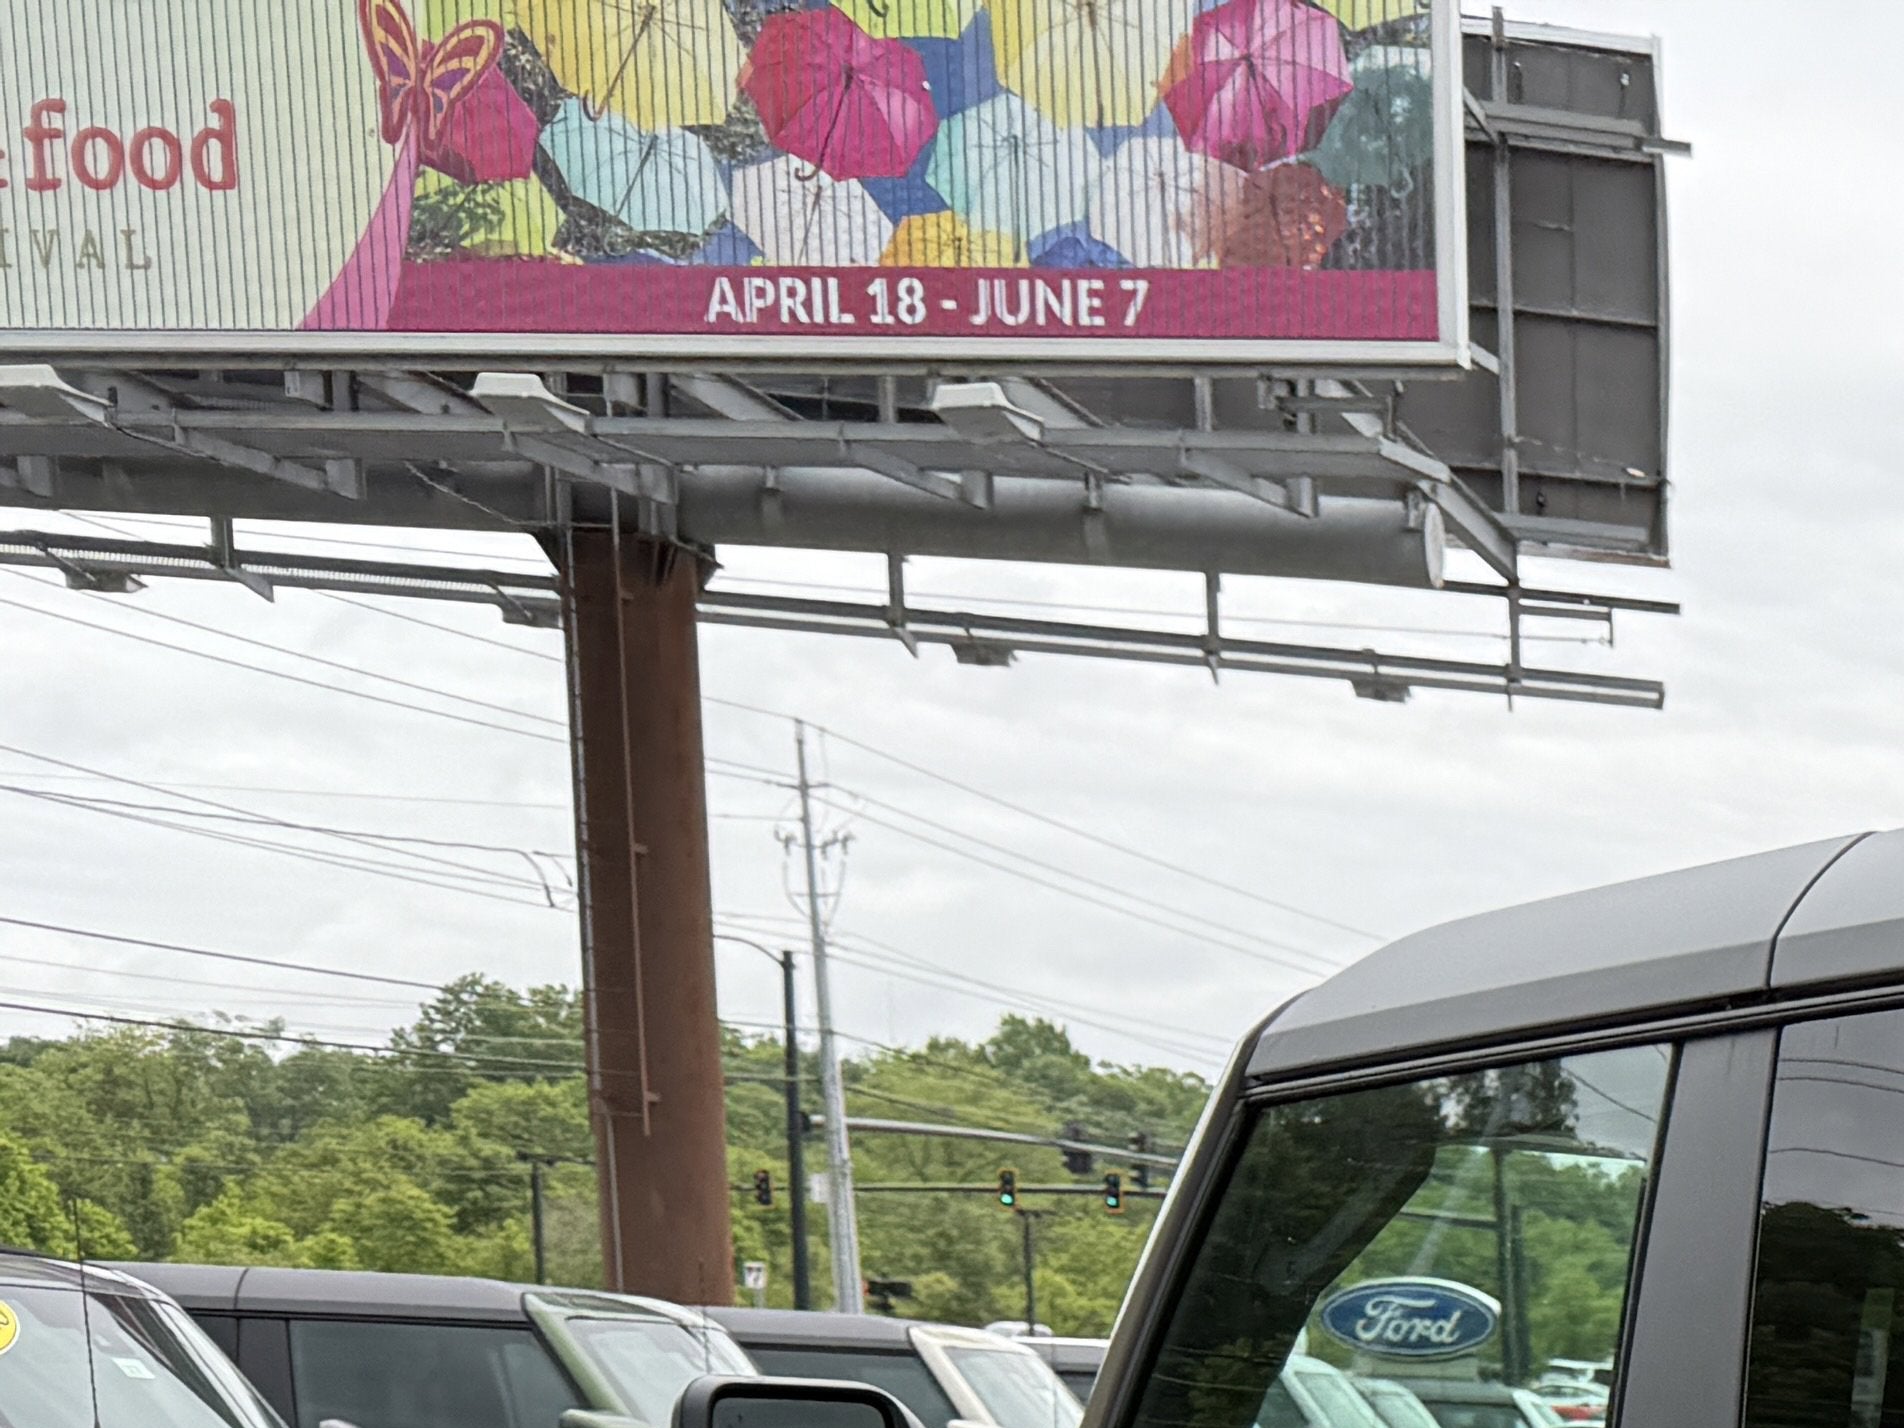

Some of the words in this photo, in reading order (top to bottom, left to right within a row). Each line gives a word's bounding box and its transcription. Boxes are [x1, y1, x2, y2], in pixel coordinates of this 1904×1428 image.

[23, 97, 238, 192] food
[703, 276, 855, 325] APRIL
[865, 277, 927, 325] 18
[970, 278, 1106, 327] JUNE
[1119, 279, 1150, 328] 7
[1355, 1294, 1463, 1344] Ford
